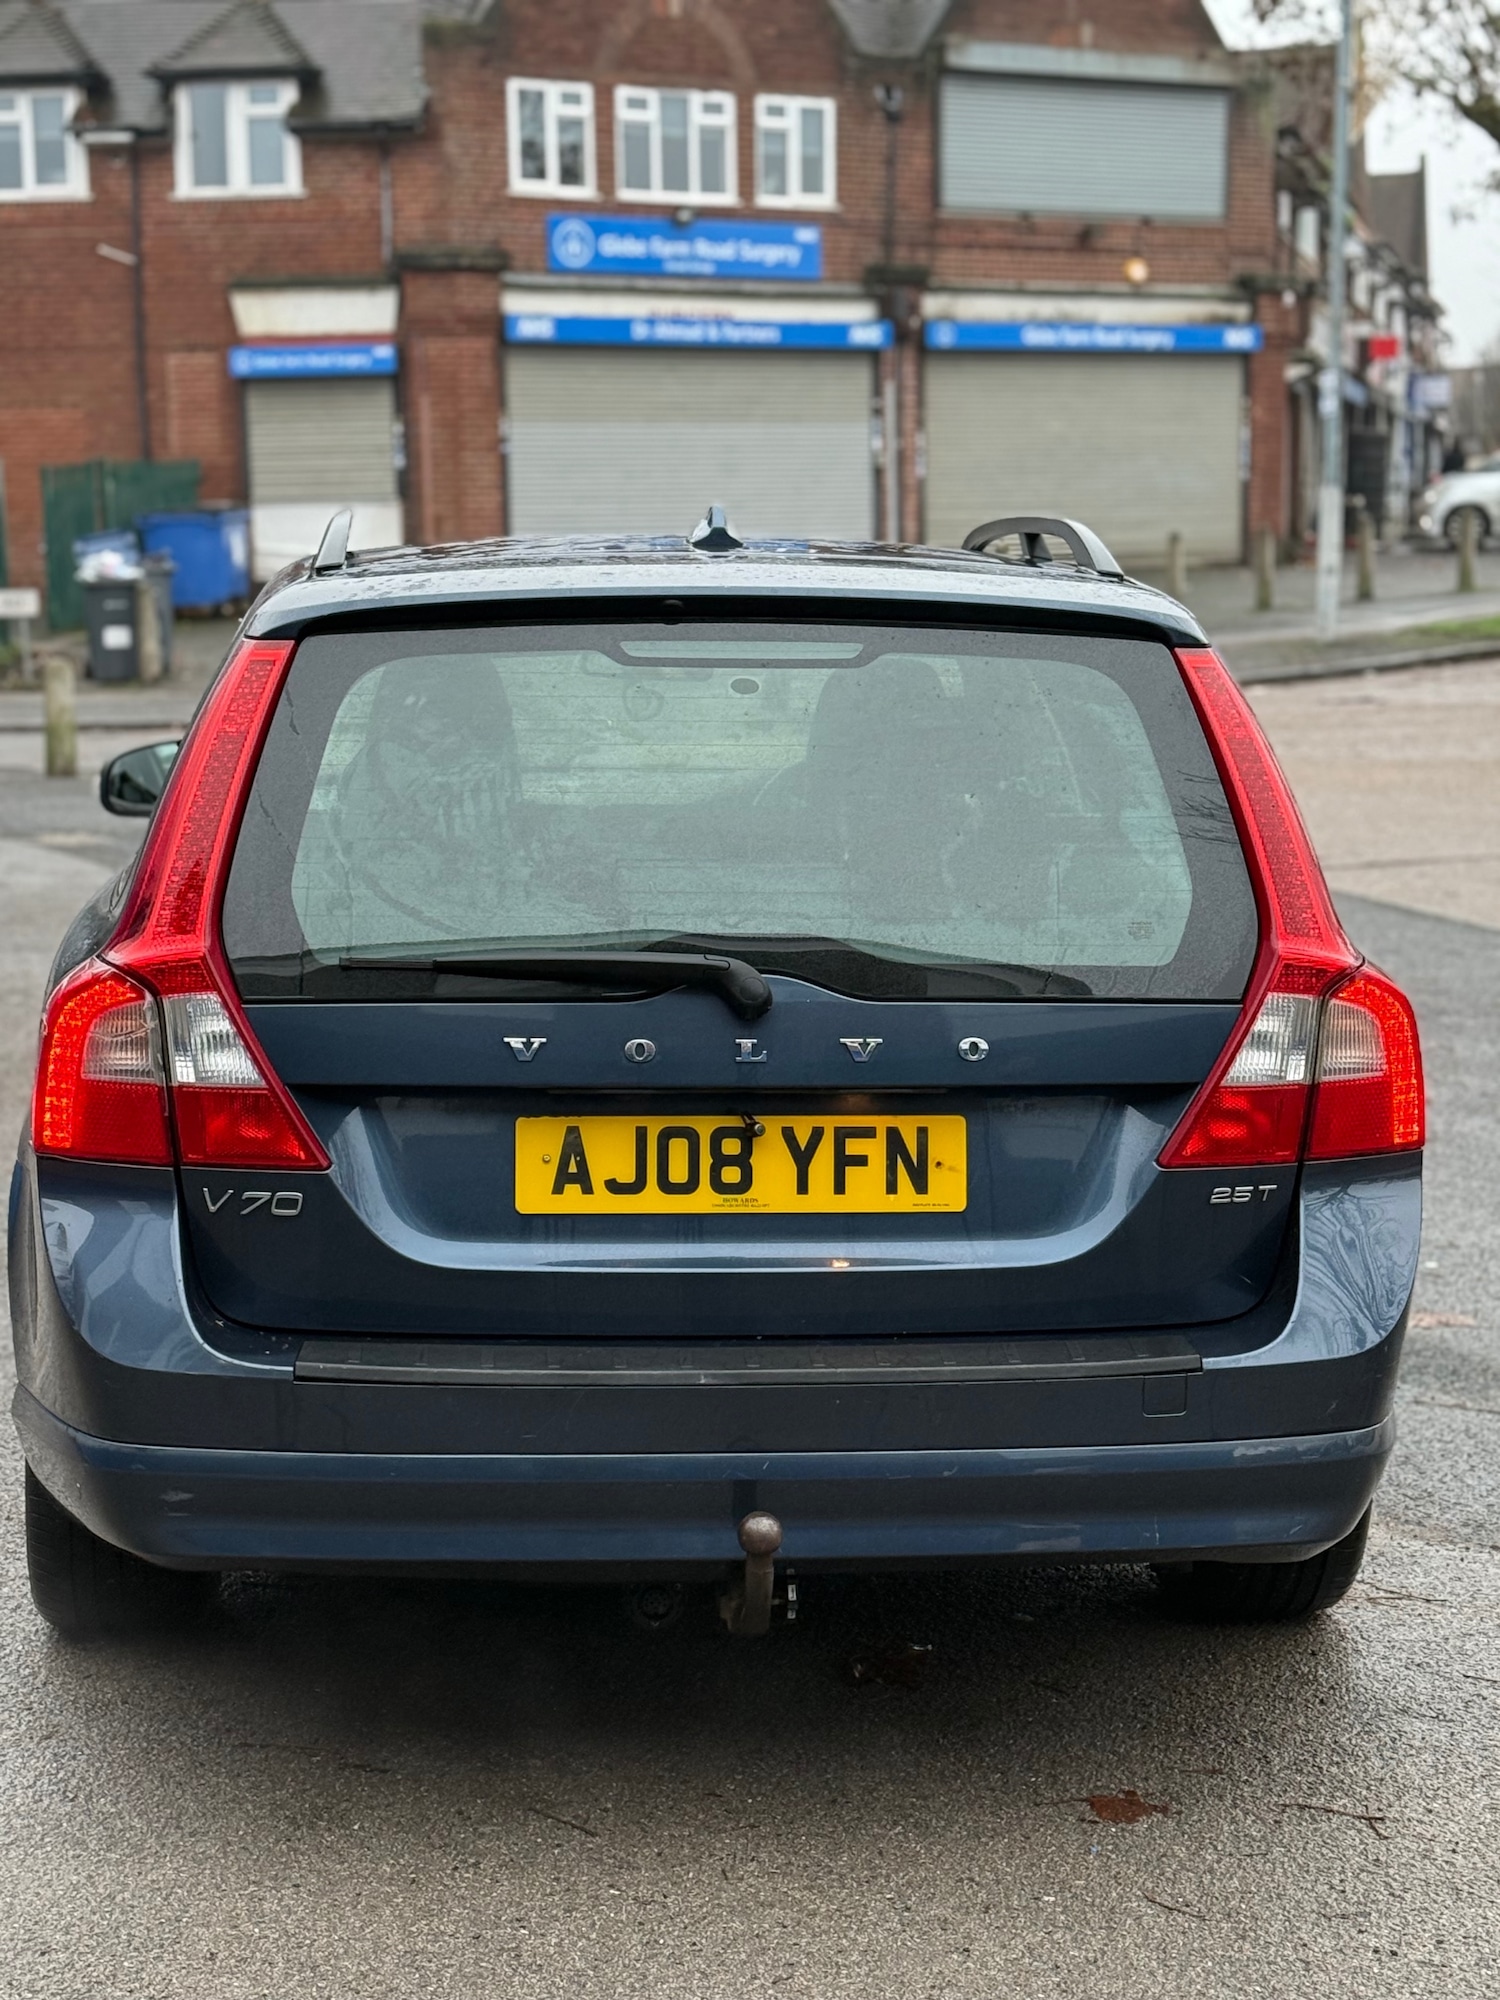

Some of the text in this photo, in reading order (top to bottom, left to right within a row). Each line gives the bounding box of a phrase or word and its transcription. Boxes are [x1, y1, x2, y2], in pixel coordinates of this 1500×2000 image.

[695, 238, 737, 261] Road
[740, 240, 801, 267] Surgery
[503, 1036, 990, 1062] VOLVO
[551, 1126, 929, 1195] AJ08 YFN
[202, 1187, 303, 1216] V70
